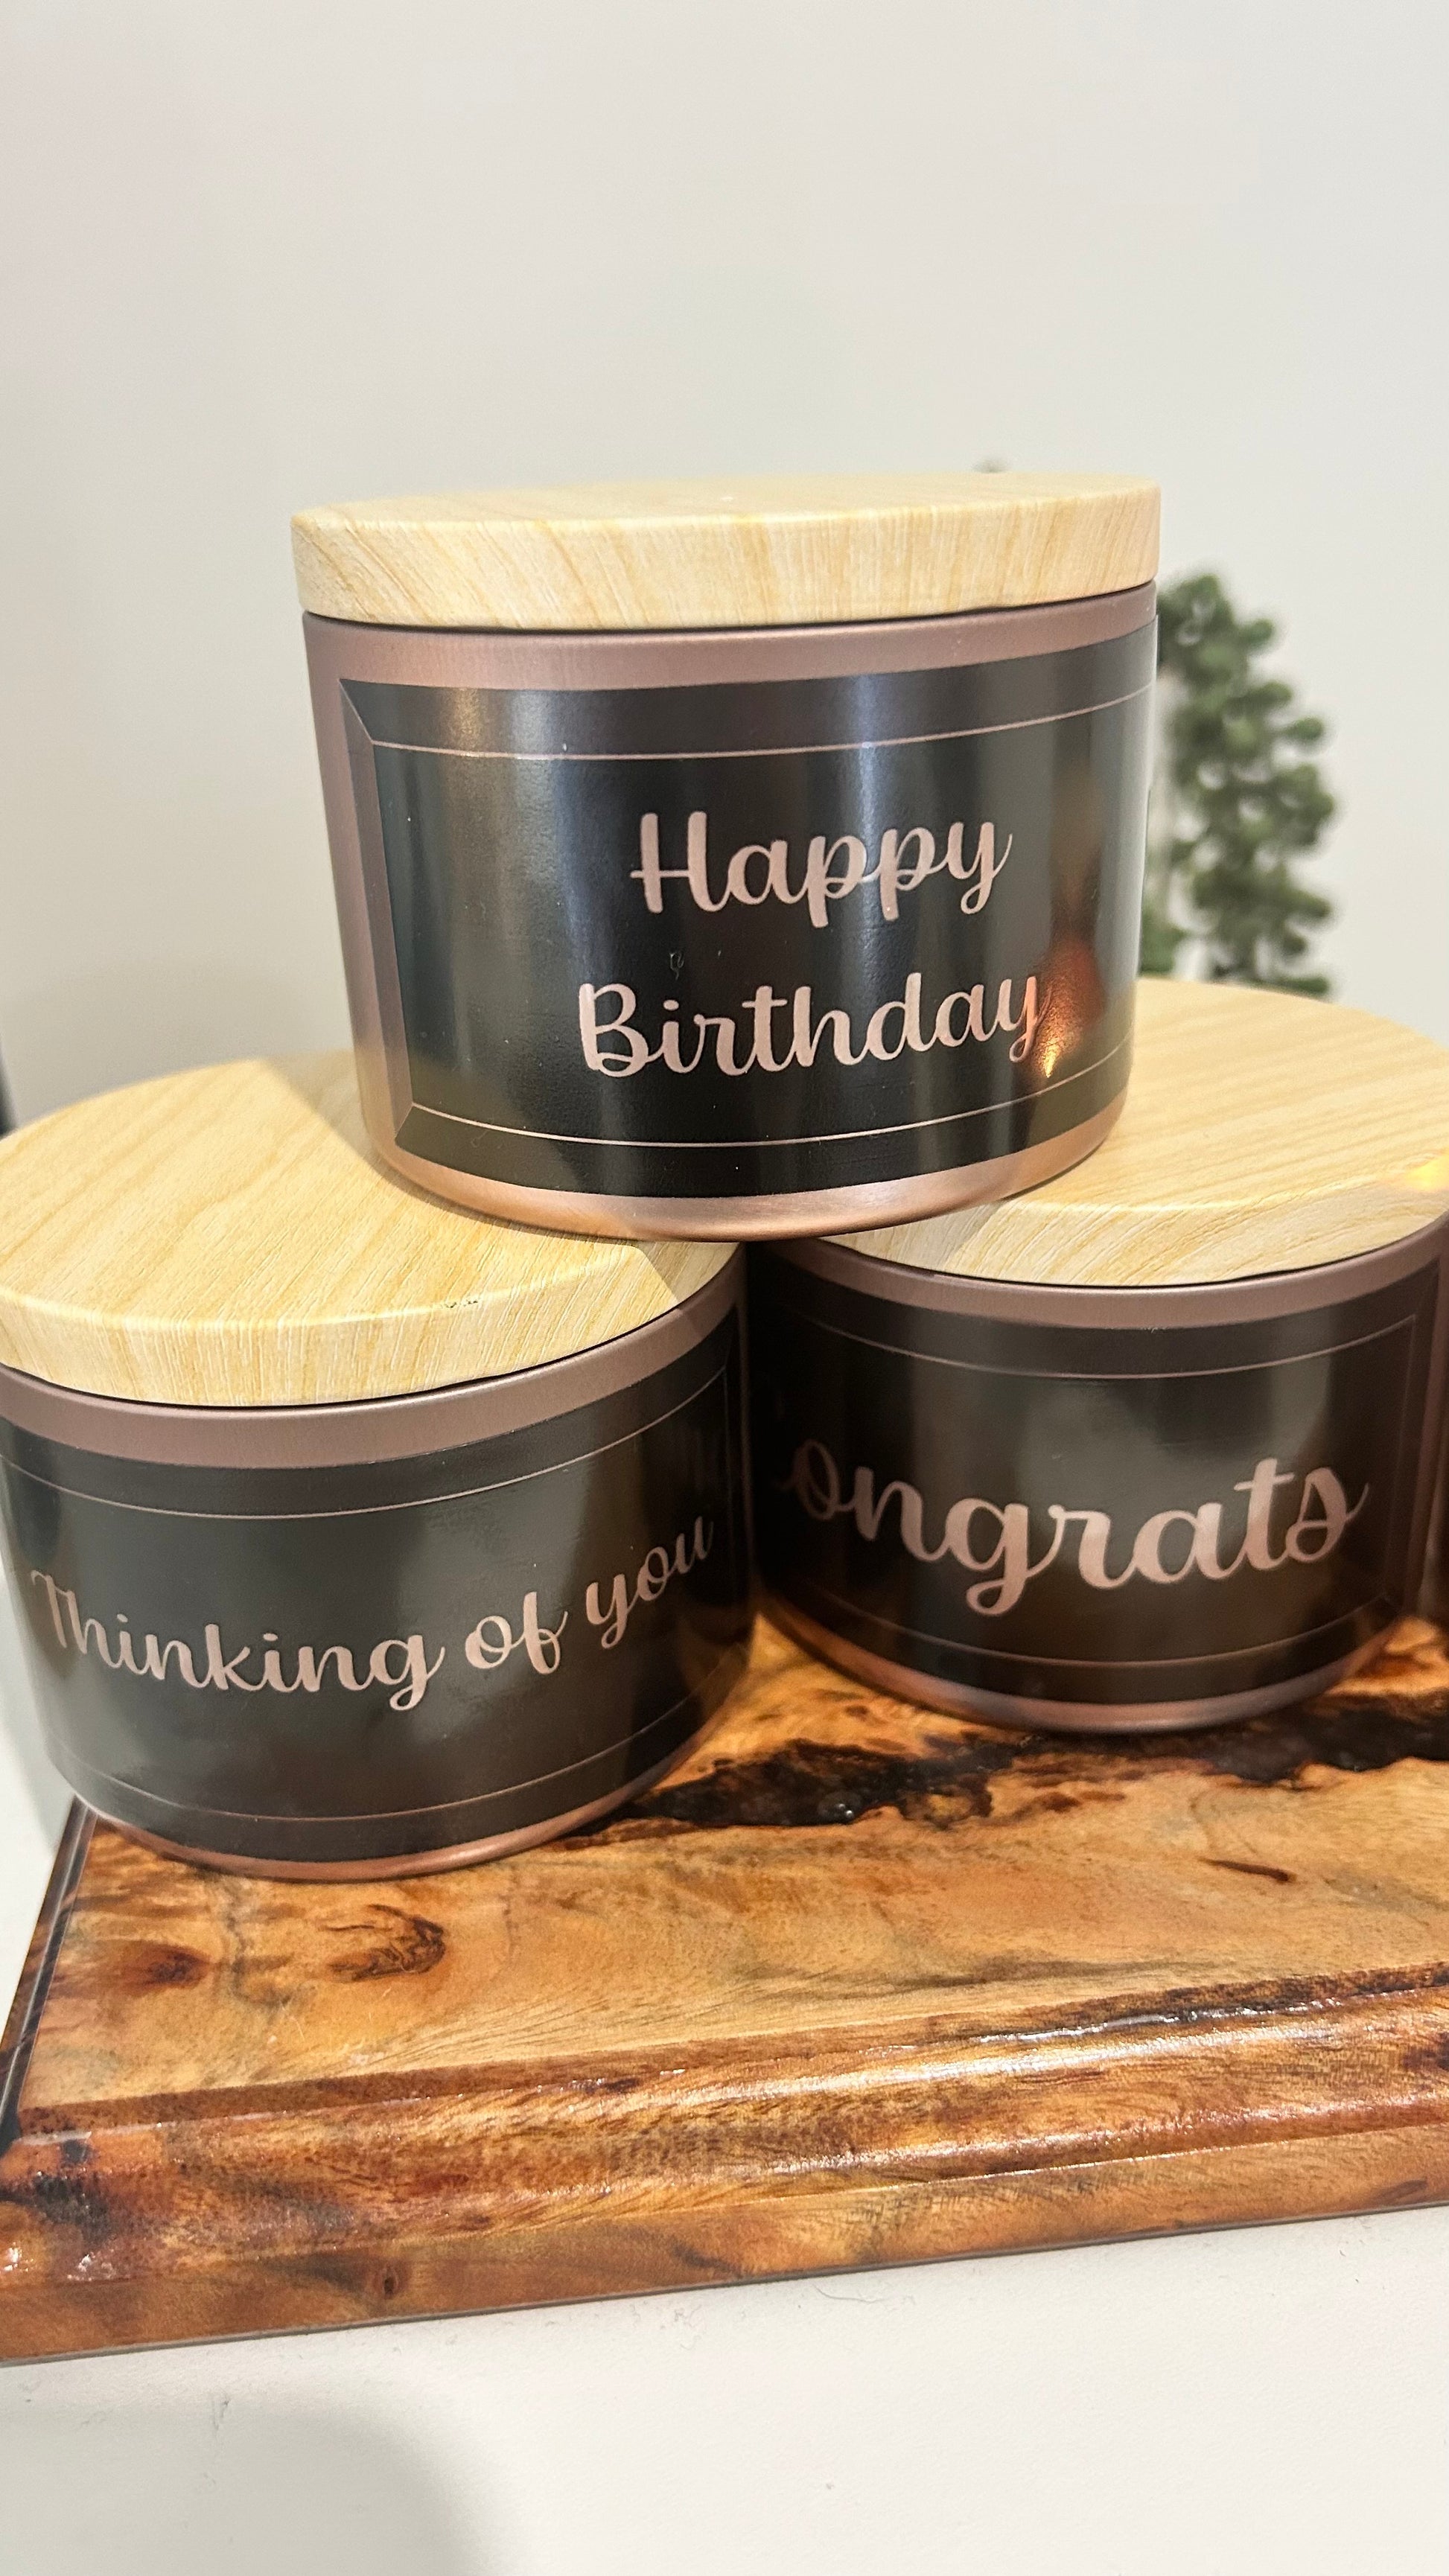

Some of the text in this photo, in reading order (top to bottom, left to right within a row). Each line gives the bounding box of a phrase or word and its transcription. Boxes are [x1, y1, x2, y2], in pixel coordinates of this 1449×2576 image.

[629, 811, 1013, 928] Happy
[578, 972, 1051, 1078] Birthday
[773, 1438, 1370, 1617] ongrats
[30, 1515, 715, 1712] Thinking of you
